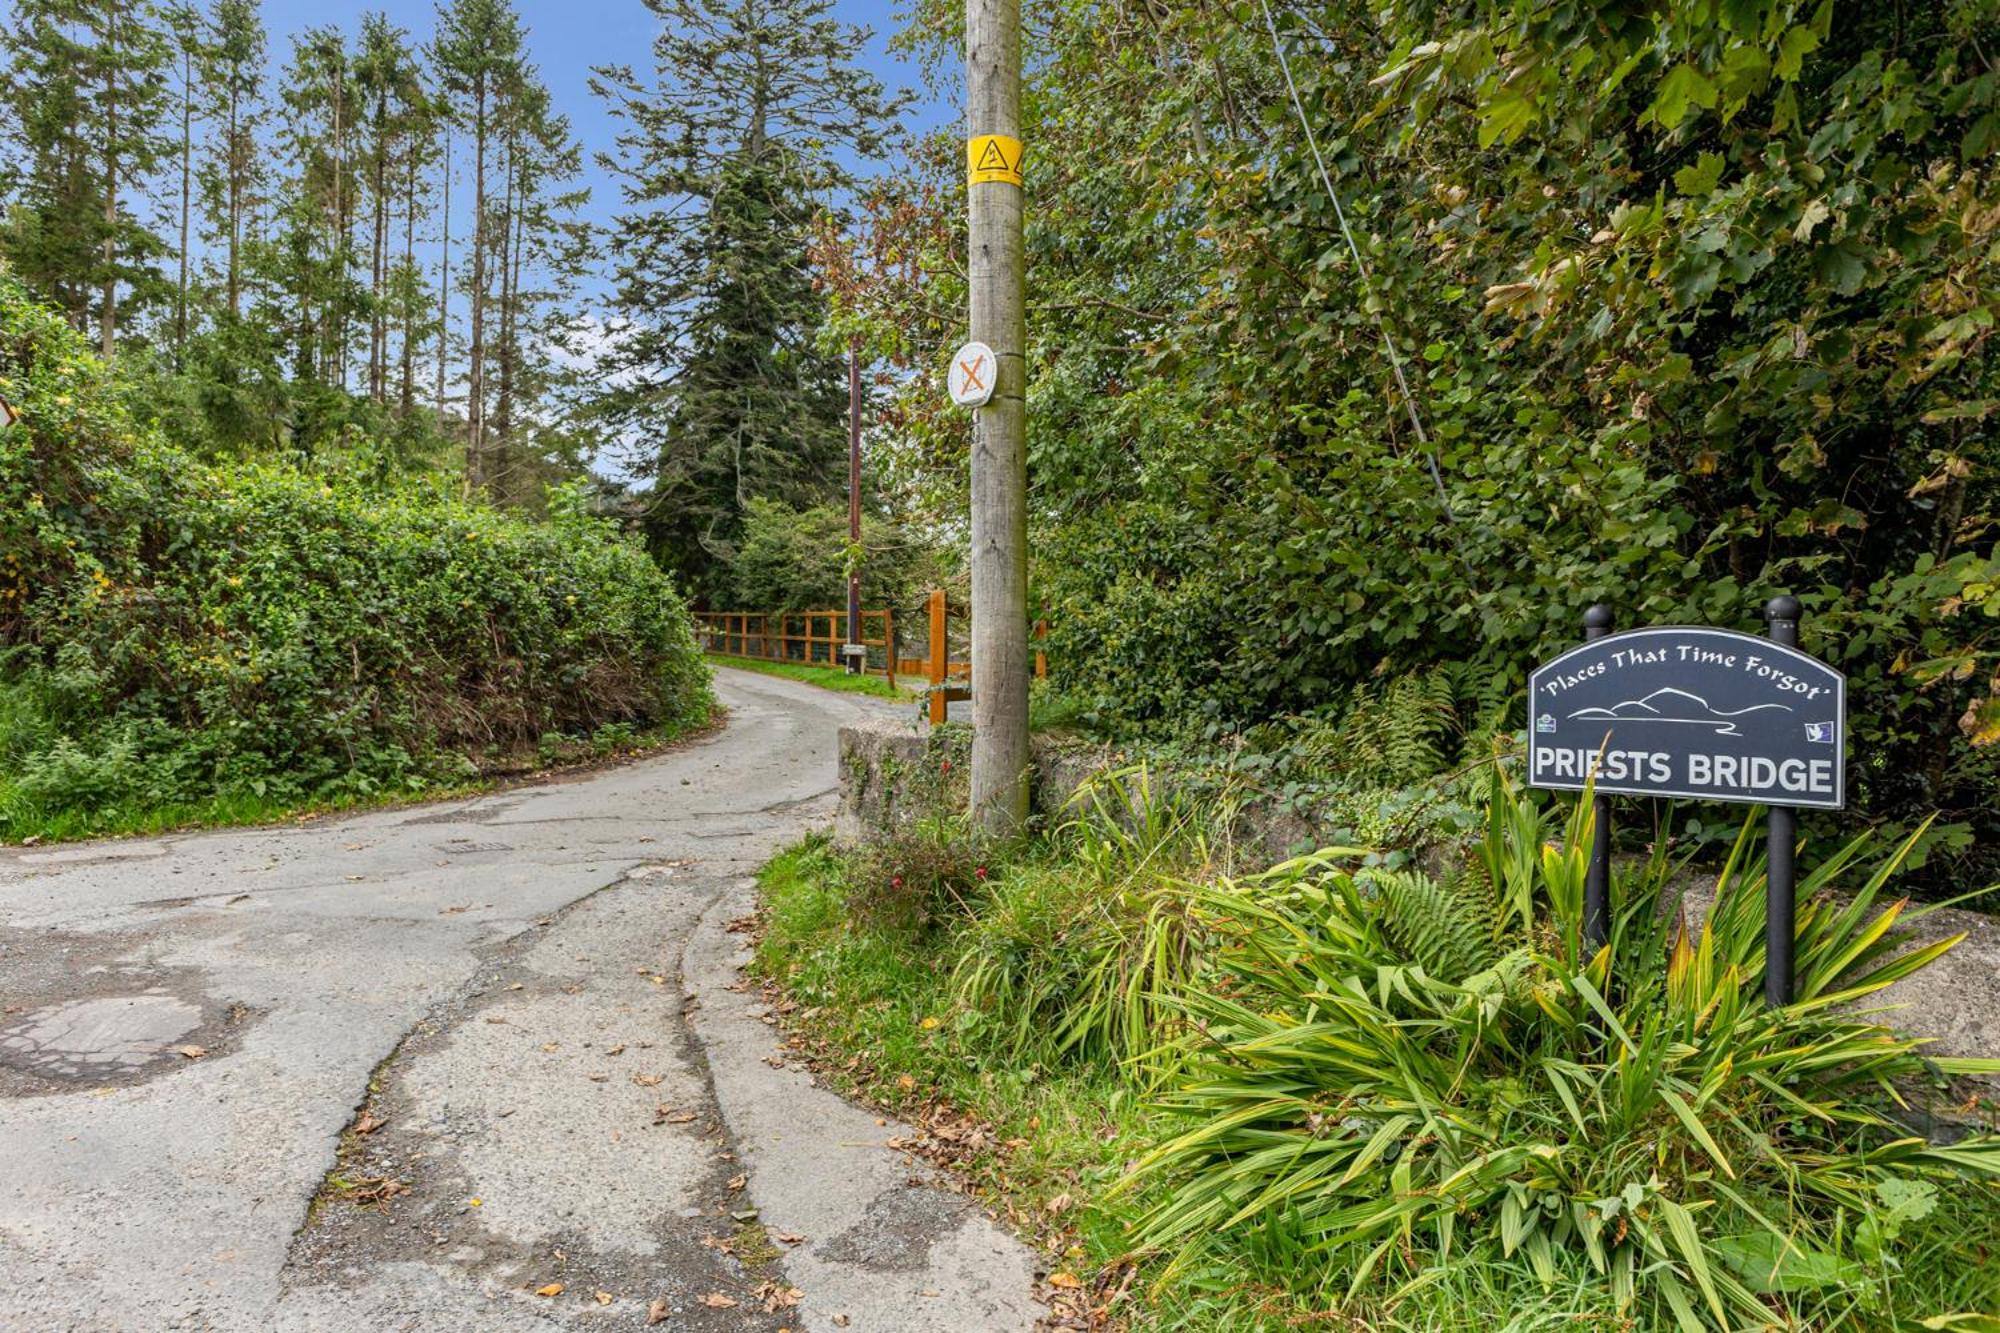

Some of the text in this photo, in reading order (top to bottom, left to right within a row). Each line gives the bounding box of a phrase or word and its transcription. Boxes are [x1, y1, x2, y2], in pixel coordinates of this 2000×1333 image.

[1611, 648, 1667, 668] That
[1676, 645, 1736, 667] Time
[1536, 747, 1832, 793] PRIESTS BRIDGE
